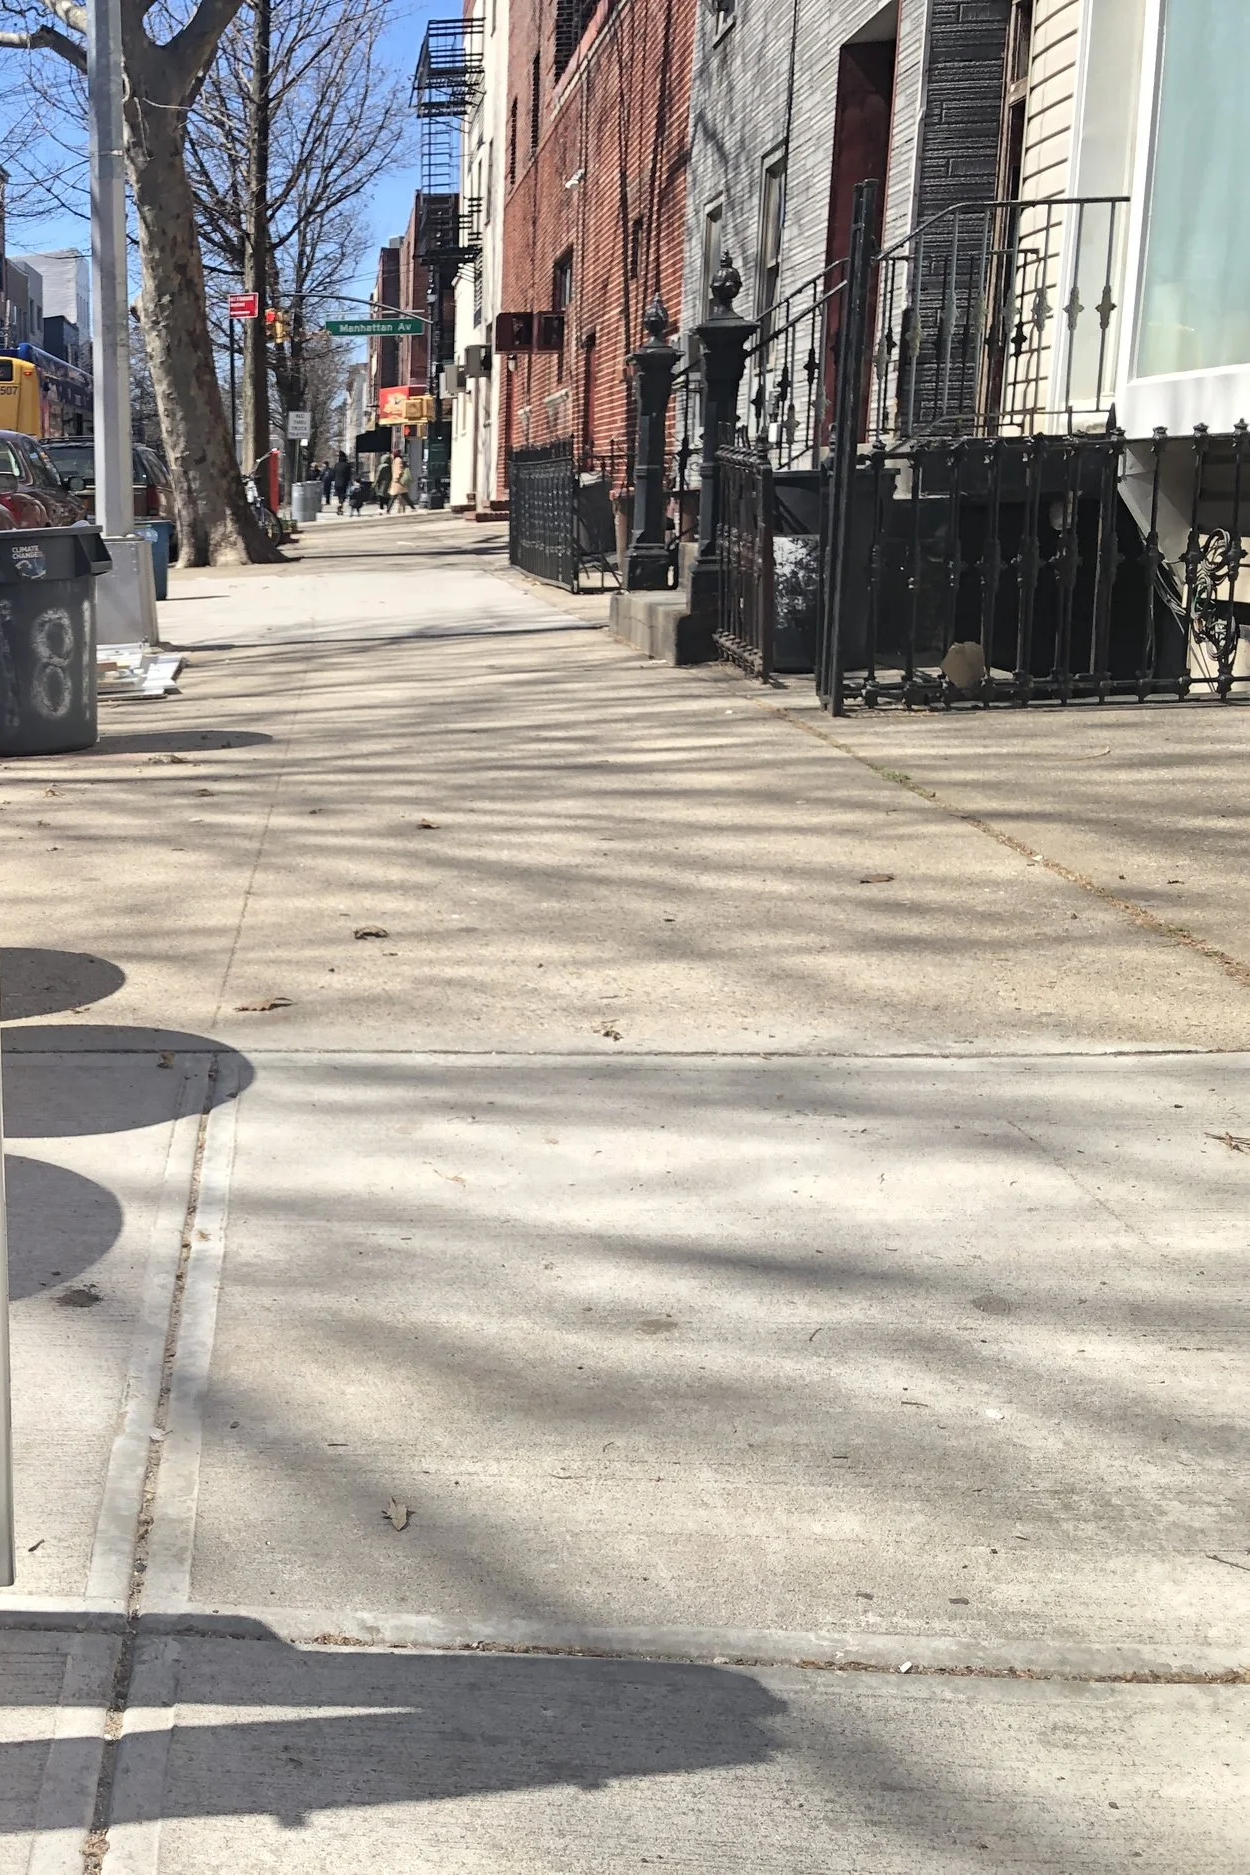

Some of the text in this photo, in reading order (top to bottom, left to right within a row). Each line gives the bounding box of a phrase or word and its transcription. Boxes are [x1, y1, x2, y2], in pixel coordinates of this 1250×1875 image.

[338, 322, 412, 333] Manhattan Av
[11, 545, 40, 553] CLIMATE
[11, 552, 40, 560] CHANGE
